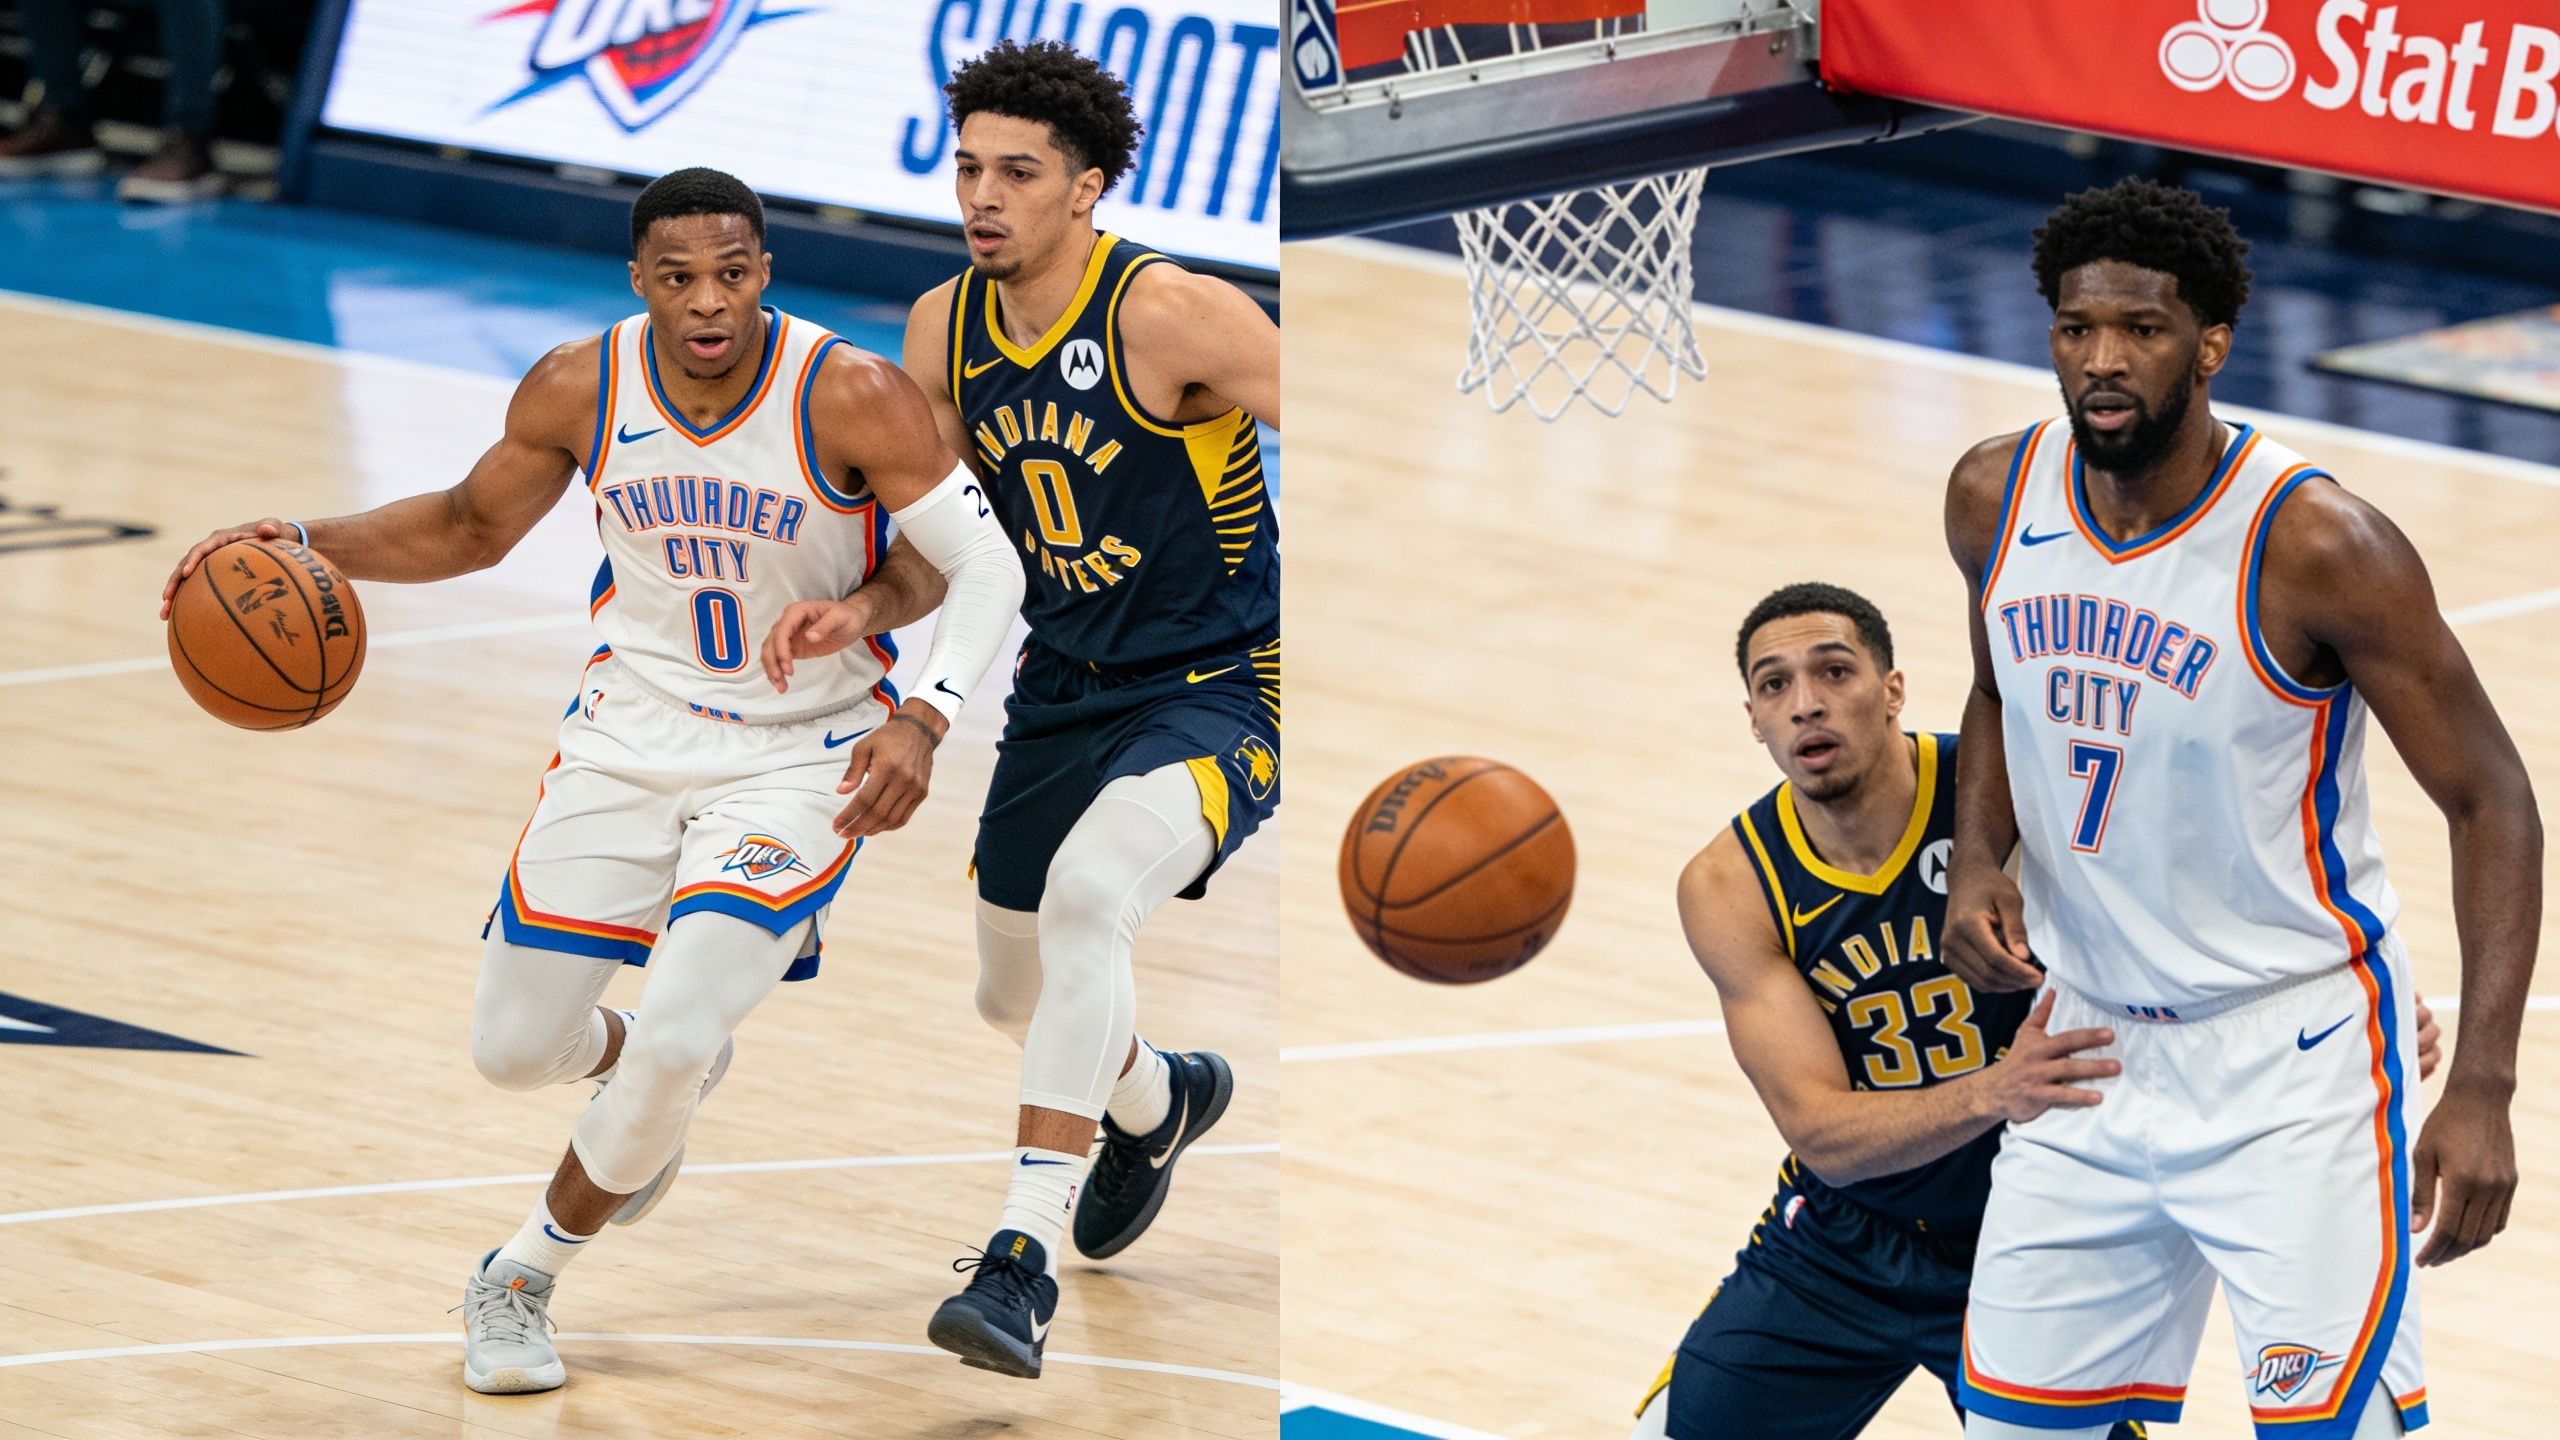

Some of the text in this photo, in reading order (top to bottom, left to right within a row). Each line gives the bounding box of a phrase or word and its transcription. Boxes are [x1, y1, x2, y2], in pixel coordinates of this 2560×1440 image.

[2302, 0, 2560, 140] Stat B
[1021, 459, 1083, 547] 0
[662, 534, 749, 582] CITY
[690, 586, 748, 673] 0
[2046, 666, 2141, 736] CITY
[2068, 738, 2123, 853] 7
[1810, 916, 1944, 1014] INDIA
[1846, 974, 1986, 1087] 33
